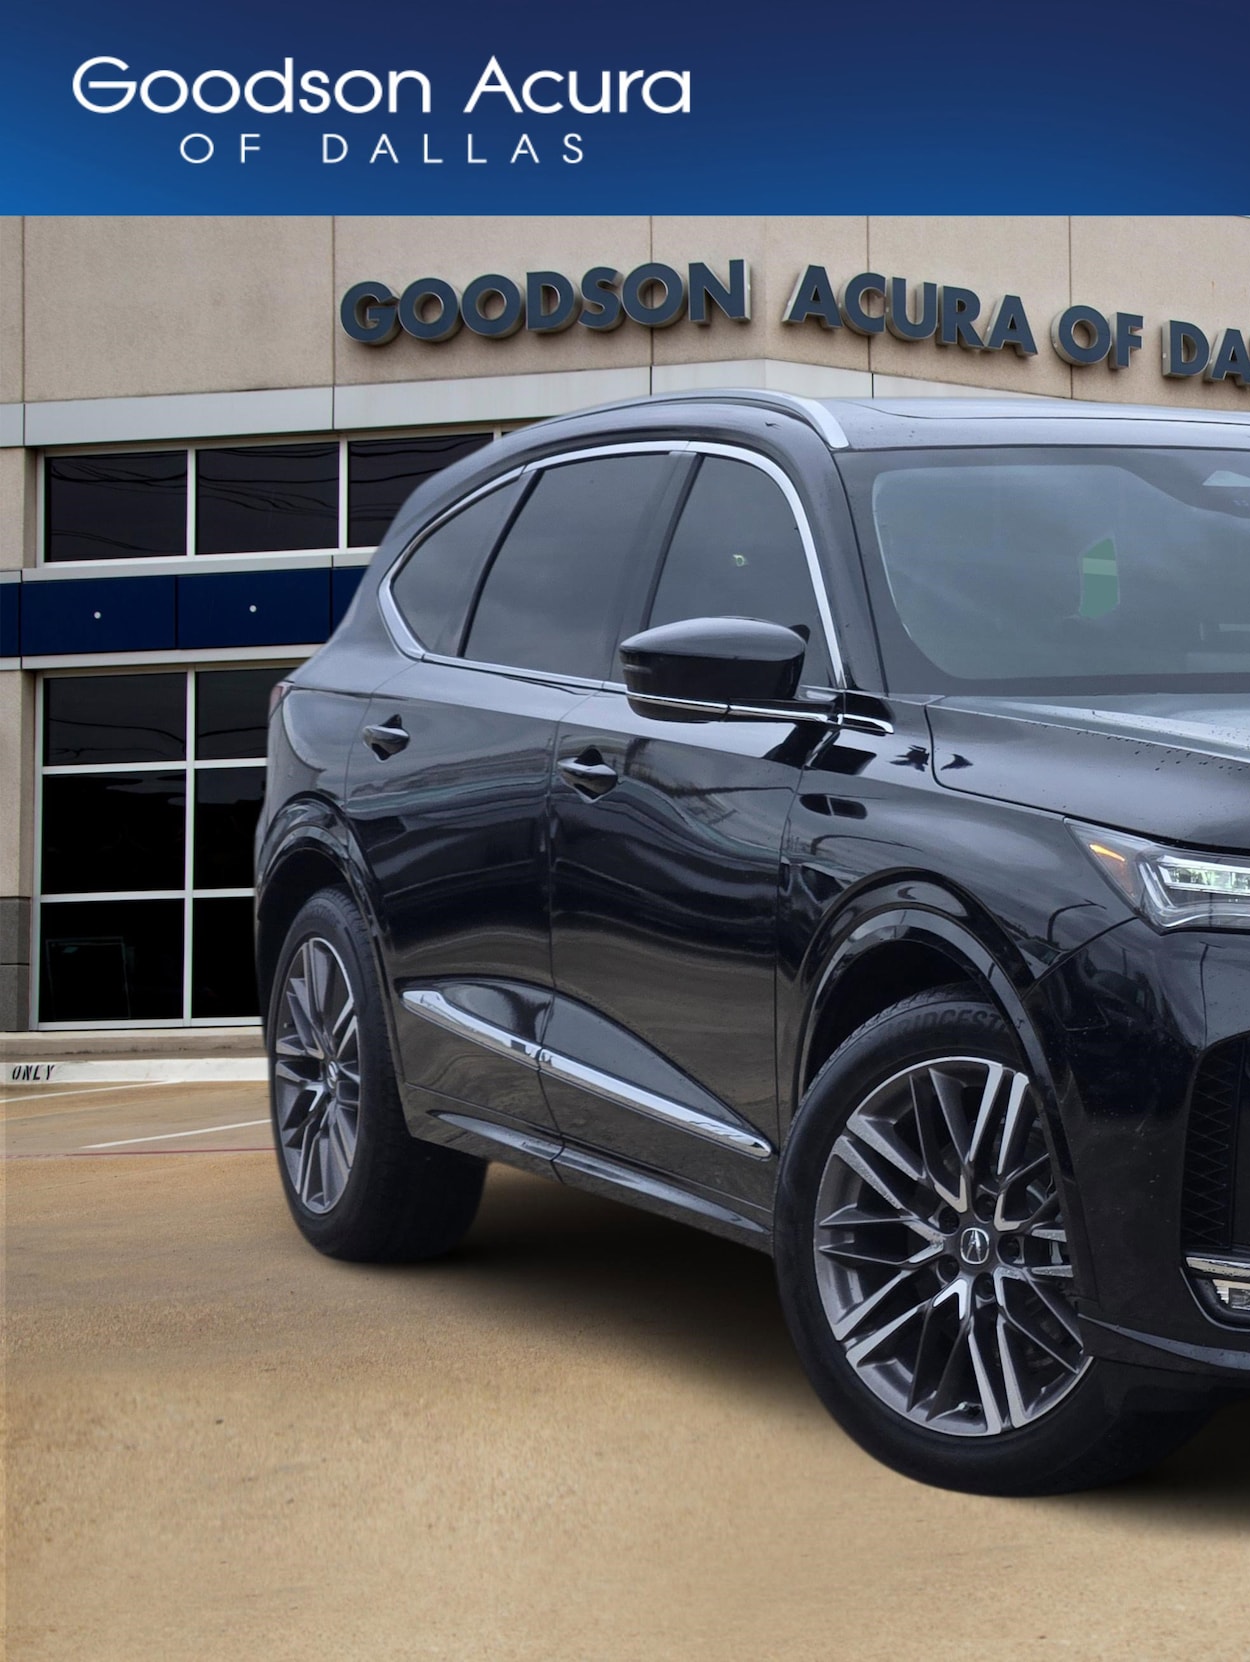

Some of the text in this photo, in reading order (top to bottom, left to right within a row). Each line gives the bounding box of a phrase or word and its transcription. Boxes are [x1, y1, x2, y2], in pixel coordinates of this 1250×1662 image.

[340, 259, 751, 345] GOODSON
[782, 264, 1038, 356] ACURA
[1050, 305, 1143, 369] OF
[12, 1064, 55, 1081] ONLY
